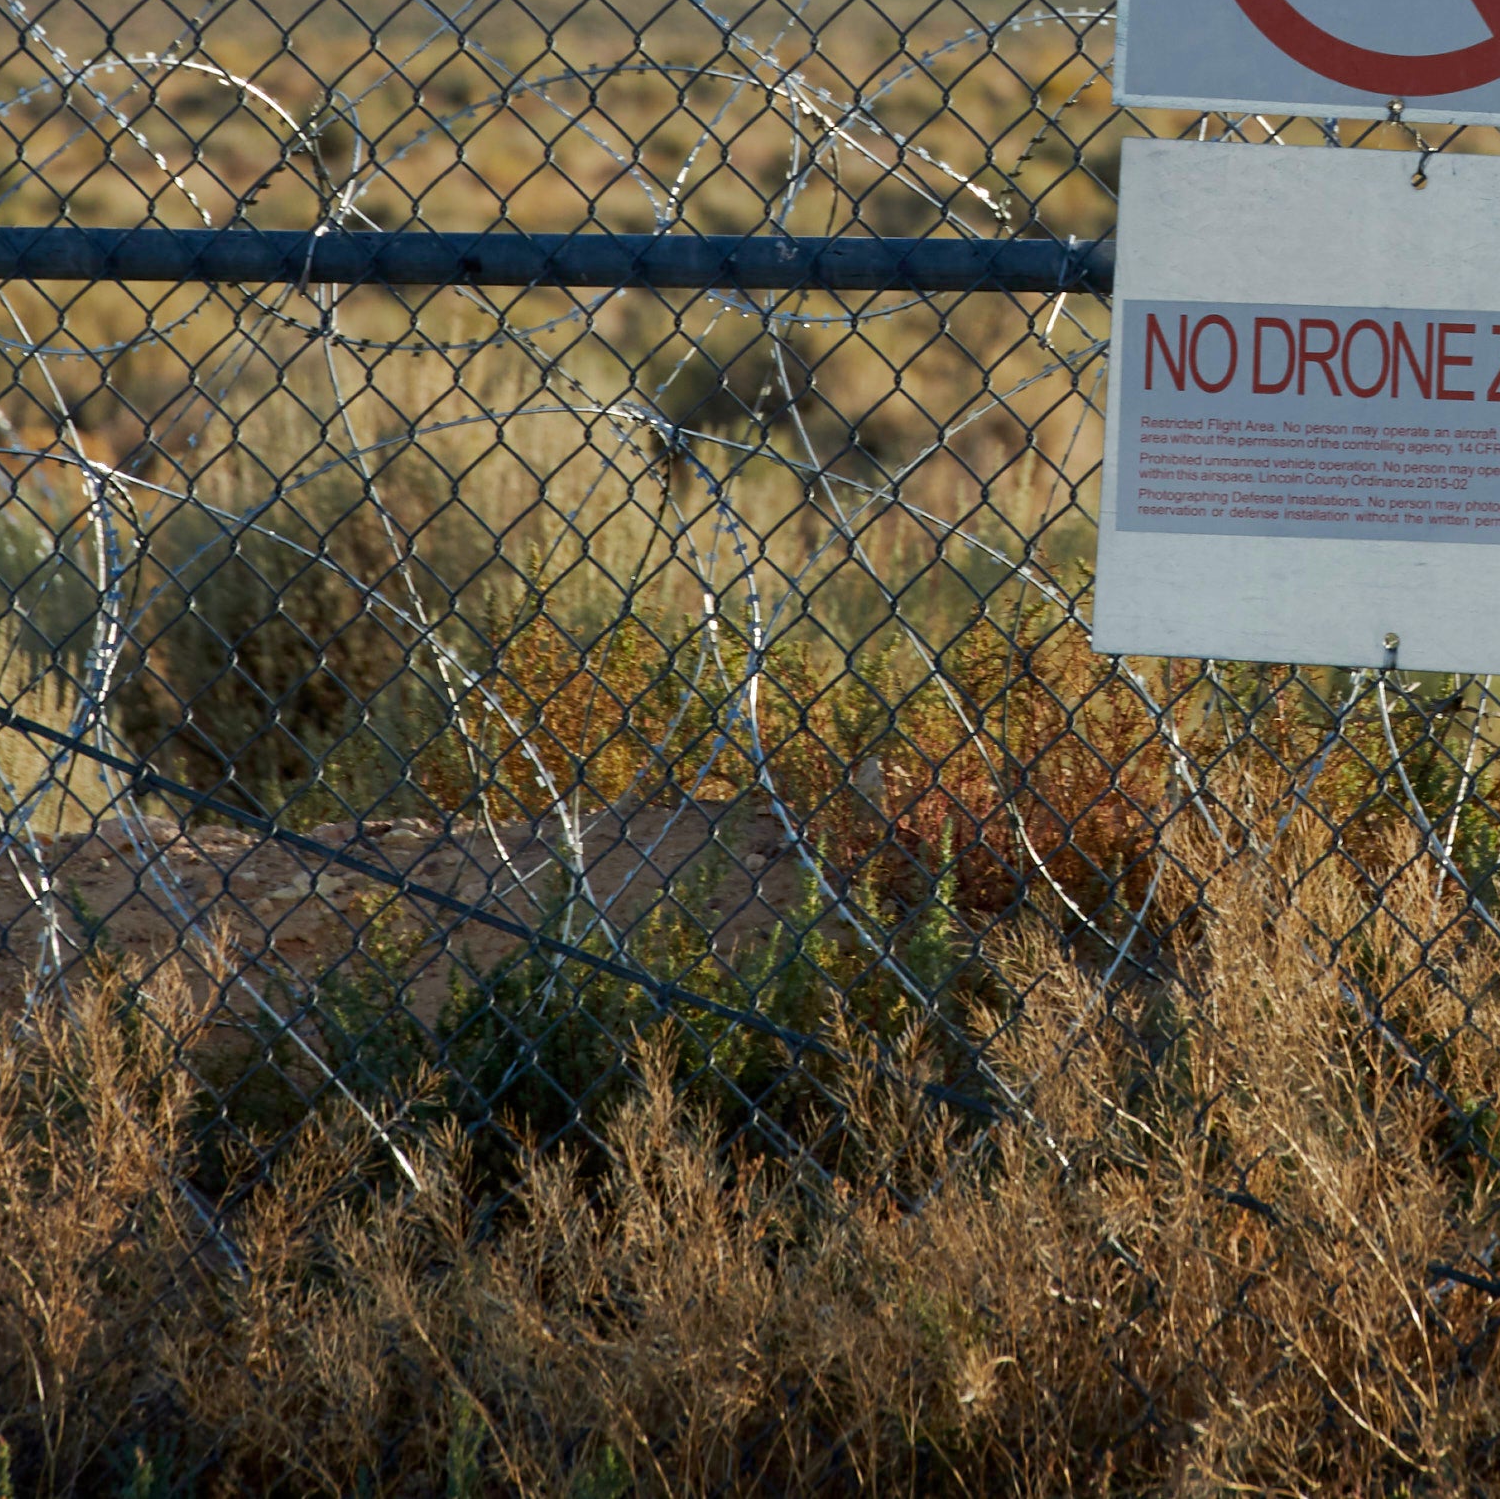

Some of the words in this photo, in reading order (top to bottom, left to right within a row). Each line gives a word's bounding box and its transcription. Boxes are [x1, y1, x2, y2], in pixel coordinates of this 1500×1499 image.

[1145, 314, 1238, 393] NO
[1252, 317, 1476, 401] DRONE
[1140, 416, 1203, 430] Restricted
[1207, 418, 1242, 434] Flight
[1283, 421, 1301, 434] No
[1305, 424, 1348, 437] person
[1352, 426, 1378, 439] may
[1383, 426, 1430, 440] operate
[1434, 429, 1450, 439] an
[1454, 427, 1497, 440] aircraft
[1140, 434, 1168, 445] area
[1170, 433, 1215, 446] without
[1216, 434, 1236, 447] the
[1238, 436, 1306, 450] permission
[1308, 438, 1321, 450] of
[1320, 438, 1339, 451] the
[1342, 439, 1405, 456] controlling
[1459, 443, 1473, 455] 14
[1139, 453, 1202, 467] Prohibited
[1204, 457, 1270, 469] unmanned
[1273, 457, 1316, 470] vehicle
[1383, 461, 1401, 473] No
[1404, 464, 1447, 477] person
[1449, 465, 1475, 479] may
[1139, 468, 1174, 481] within
[1176, 469, 1198, 481] this
[1259, 471, 1303, 485] Lincoln
[1305, 473, 1348, 489] County
[1351, 475, 1415, 489] Ordinance
[1417, 477, 1468, 491] 2015-02
[1138, 487, 1228, 505] Photographing
[1232, 491, 1284, 504] Defense
[1368, 495, 1386, 508] No
[1389, 498, 1431, 511] person
[1435, 500, 1461, 513] may
[1138, 504, 1206, 517] reservation
[1211, 508, 1224, 518] or
[1229, 506, 1279, 520] defense
[1284, 508, 1349, 522] installation
[1355, 511, 1398, 524] without
[1404, 512, 1424, 525] the
[1428, 513, 1469, 526] written
